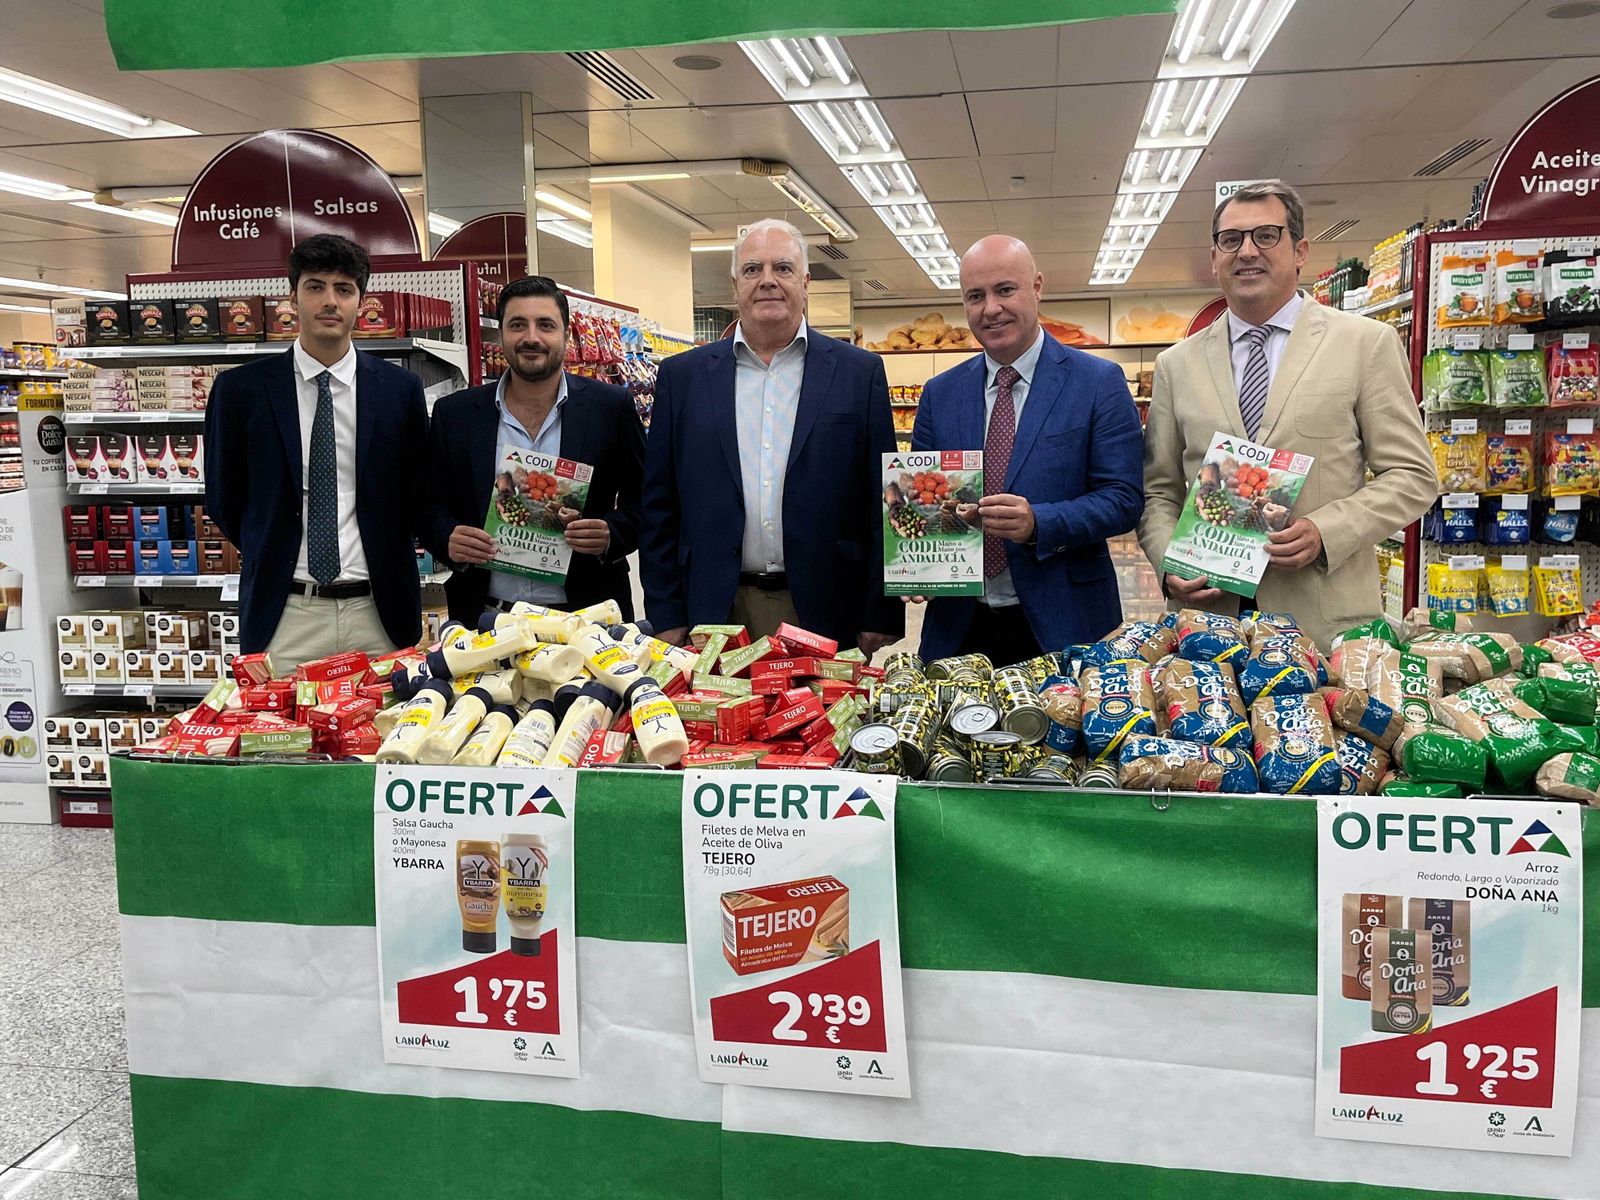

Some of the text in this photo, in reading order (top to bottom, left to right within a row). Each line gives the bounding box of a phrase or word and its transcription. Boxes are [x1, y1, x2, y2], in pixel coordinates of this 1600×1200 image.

[1531, 149, 1600, 169] Aceite
[1520, 175, 1600, 197] Vinagr
[194, 204, 282, 222] Infusiones
[314, 198, 378, 216] Salsas
[219, 221, 260, 239] Café
[1560, 269, 1593, 278] MENTOLIN
[70, 370, 96, 379] NESCAFÉ
[139, 368, 165, 377] NESCAFÉ
[63, 381, 89, 389] NESCAFÉ
[140, 379, 165, 388] NESCAFÉ
[65, 392, 91, 400] NESCAFÉ
[140, 390, 167, 398] NESCAFÉ
[66, 402, 92, 411] NESCAFÉ
[141, 401, 168, 410] NESCAFÉ
[1238, 444, 1270, 463] CODI
[525, 454, 553, 469] CODI
[907, 456, 936, 467] CODI
[1446, 519, 1474, 527] HALLS
[1500, 519, 1528, 527] HALLS
[499, 525, 535, 542] CODI
[1194, 522, 1236, 546] CODI
[899, 540, 939, 553] CODI
[900, 551, 966, 563] ANDALUCÍA
[735, 647, 754, 663] TEJERO
[1402, 654, 1426, 664] ARROZ
[327, 665, 352, 676] TEJERO
[769, 661, 794, 671] TEJERO
[712, 677, 737, 687] TEJERO
[677, 704, 701, 713] TEJERO
[783, 705, 806, 721] TEJERO
[181, 724, 224, 737] TEJERO
[261, 734, 291, 743] TEJERO
[582, 744, 600, 769] ERO
[686, 751, 733, 759] TEJERO
[392, 817, 454, 829] Salsa Gaucha
[392, 828, 416, 836] 300ml
[701, 824, 737, 836] Filetes
[740, 825, 753, 836] de
[756, 825, 789, 837] Melva
[392, 837, 447, 848] o Mayonesa
[701, 837, 783, 849] Aceite de Oliva
[392, 846, 416, 854] 400ml
[393, 857, 445, 870] YBARRA
[702, 852, 755, 866] TEJERO
[703, 865, 720, 877] 78g
[1524, 862, 1559, 873] Arroz
[465, 879, 492, 887] YBARRA
[508, 879, 539, 887] YBARRA
[1416, 871, 1462, 882] Redondo,
[1464, 873, 1493, 884] Largo
[1504, 875, 1559, 886] Vaporizado
[506, 890, 543, 898] mayonesa
[787, 881, 844, 898] TEJERO
[1465, 884, 1559, 903] DOÑA ANA
[464, 901, 494, 911] Gaucha
[1541, 903, 1559, 914] 1kg
[738, 905, 817, 939] TEJERO
[1349, 928, 1373, 945] Do
[740, 941, 793, 956] Filetes de Melva
[1431, 937, 1463, 952] oña
[1379, 962, 1425, 979] Doña
[1393, 977, 1427, 994] Ana
[395, 1033, 450, 1049] LANDALUZ
[710, 1051, 769, 1067] LANDALUZ
[1332, 1105, 1404, 1123] LANDALUZ
